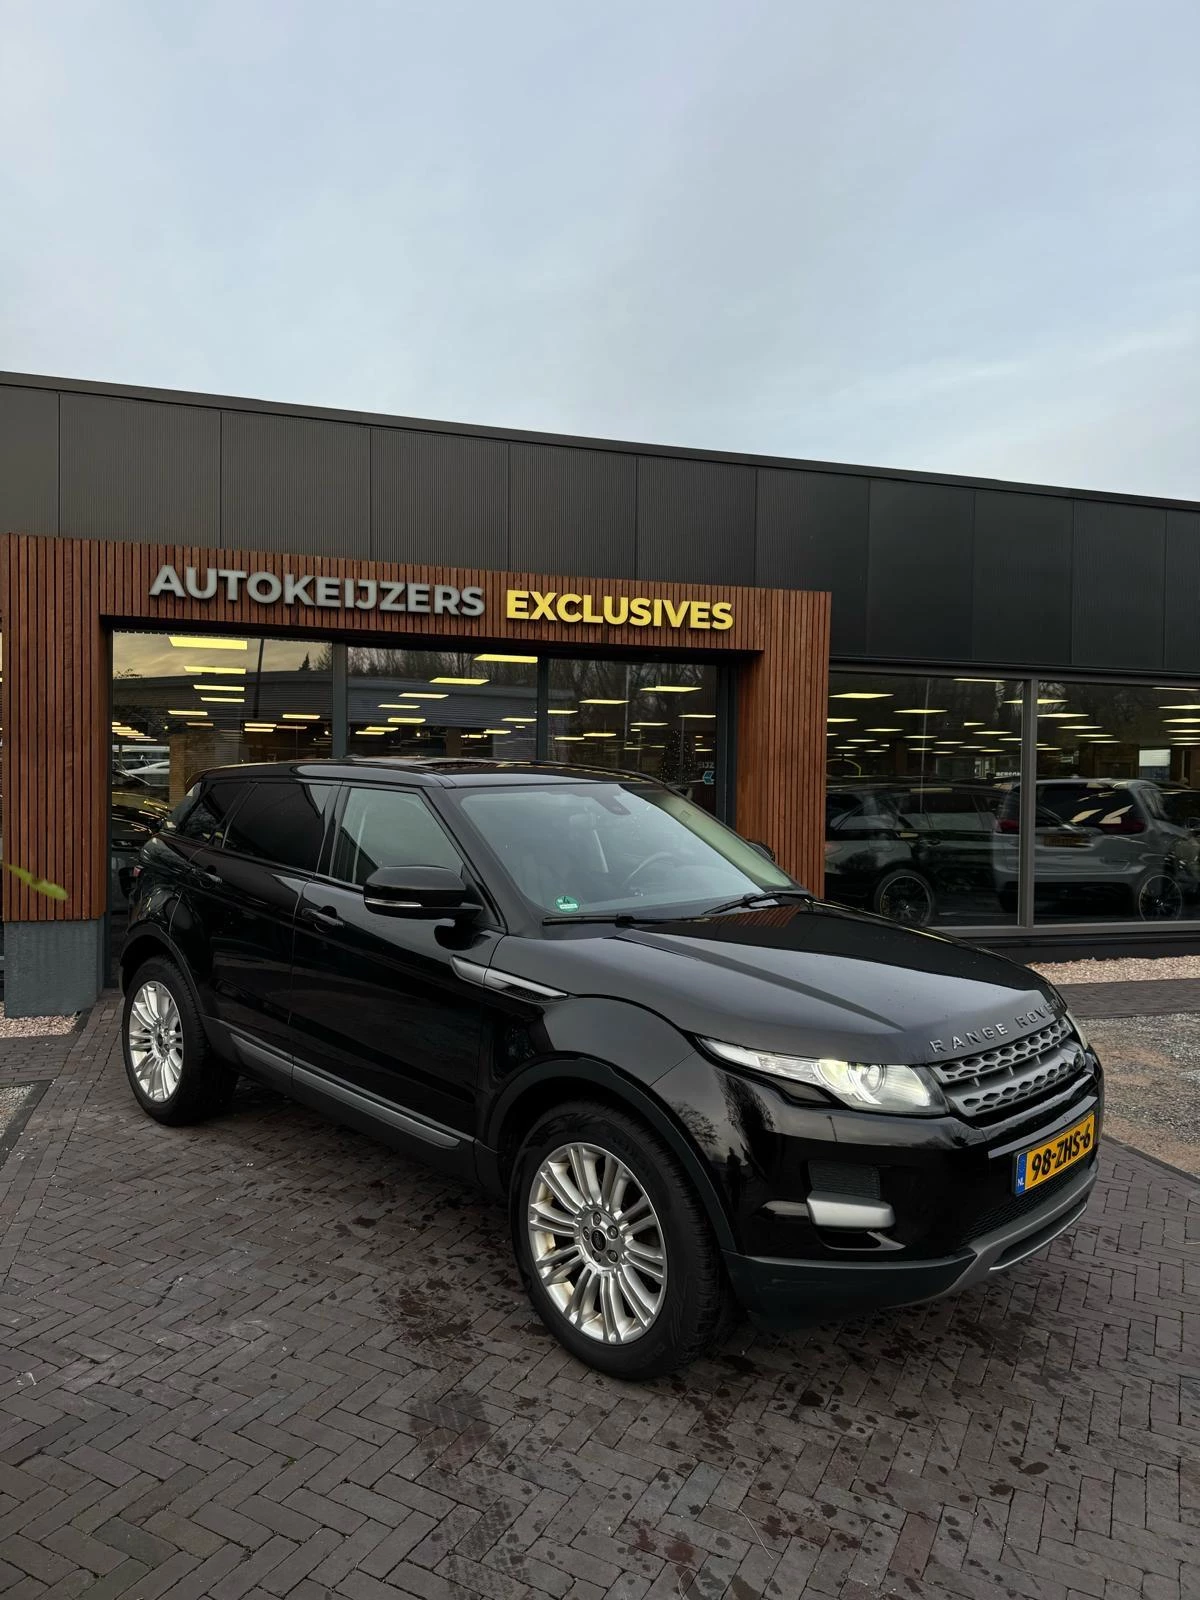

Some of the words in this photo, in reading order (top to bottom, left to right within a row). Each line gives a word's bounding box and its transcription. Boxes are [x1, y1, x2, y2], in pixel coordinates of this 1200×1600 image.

[149, 564, 486, 617] AUTOKEIJZERS
[506, 589, 735, 631] EXCLUSIVES
[929, 1022, 1009, 1054] RANGE
[1031, 1122, 1091, 1182] 98-ZHS-6
